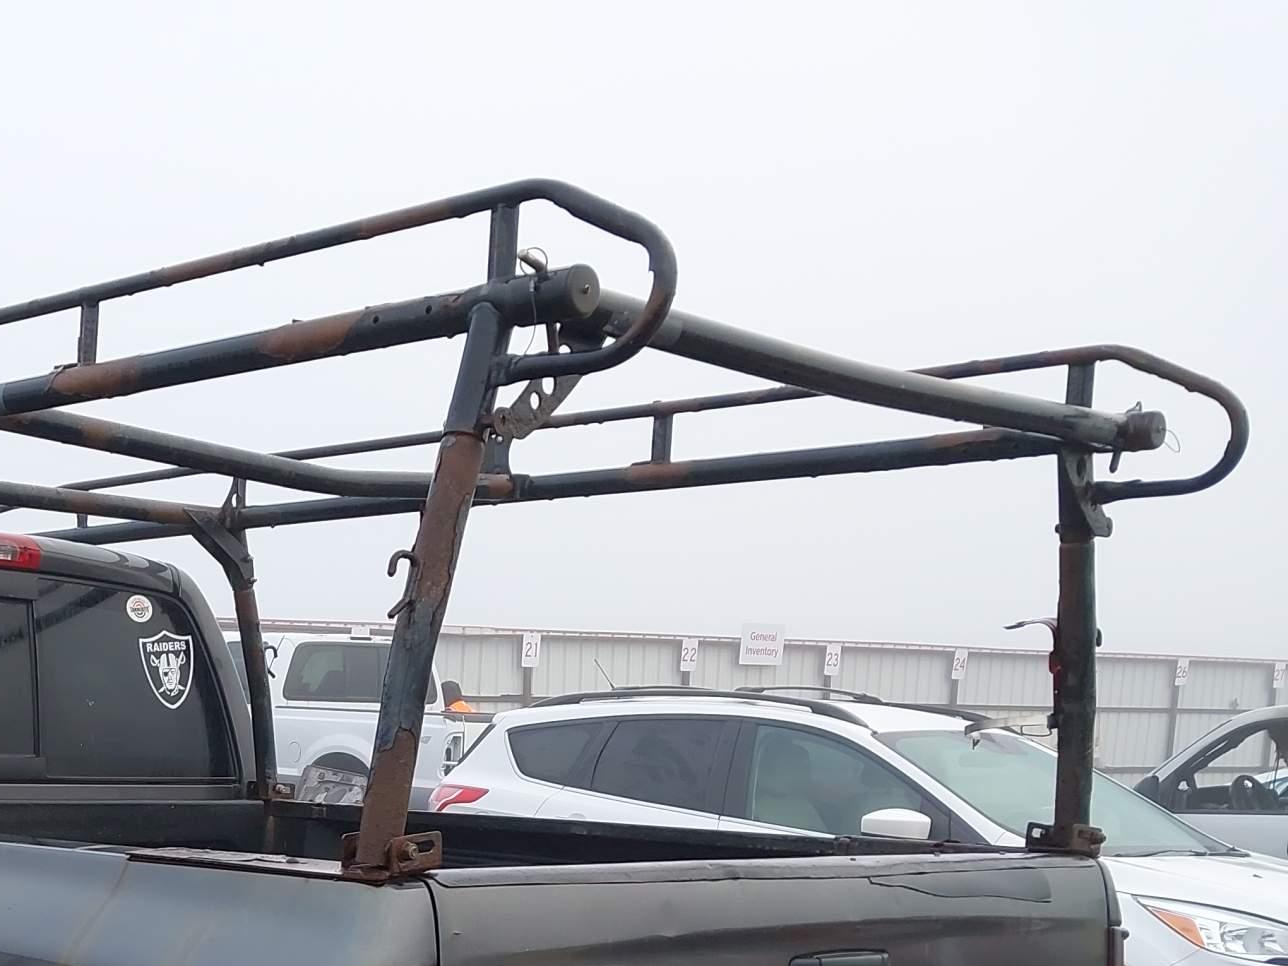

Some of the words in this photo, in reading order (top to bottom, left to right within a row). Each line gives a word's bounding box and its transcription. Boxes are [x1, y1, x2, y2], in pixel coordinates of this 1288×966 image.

[749, 631, 777, 642] General
[146, 641, 187, 653] RAIDERS
[524, 641, 539, 658] 21
[745, 645, 779, 659] Inventory
[682, 647, 697, 663] 22
[826, 653, 839, 668] 23
[953, 657, 966, 672] 24
[1176, 664, 1188, 679] 26
[1273, 668, 1286, 681] 27
